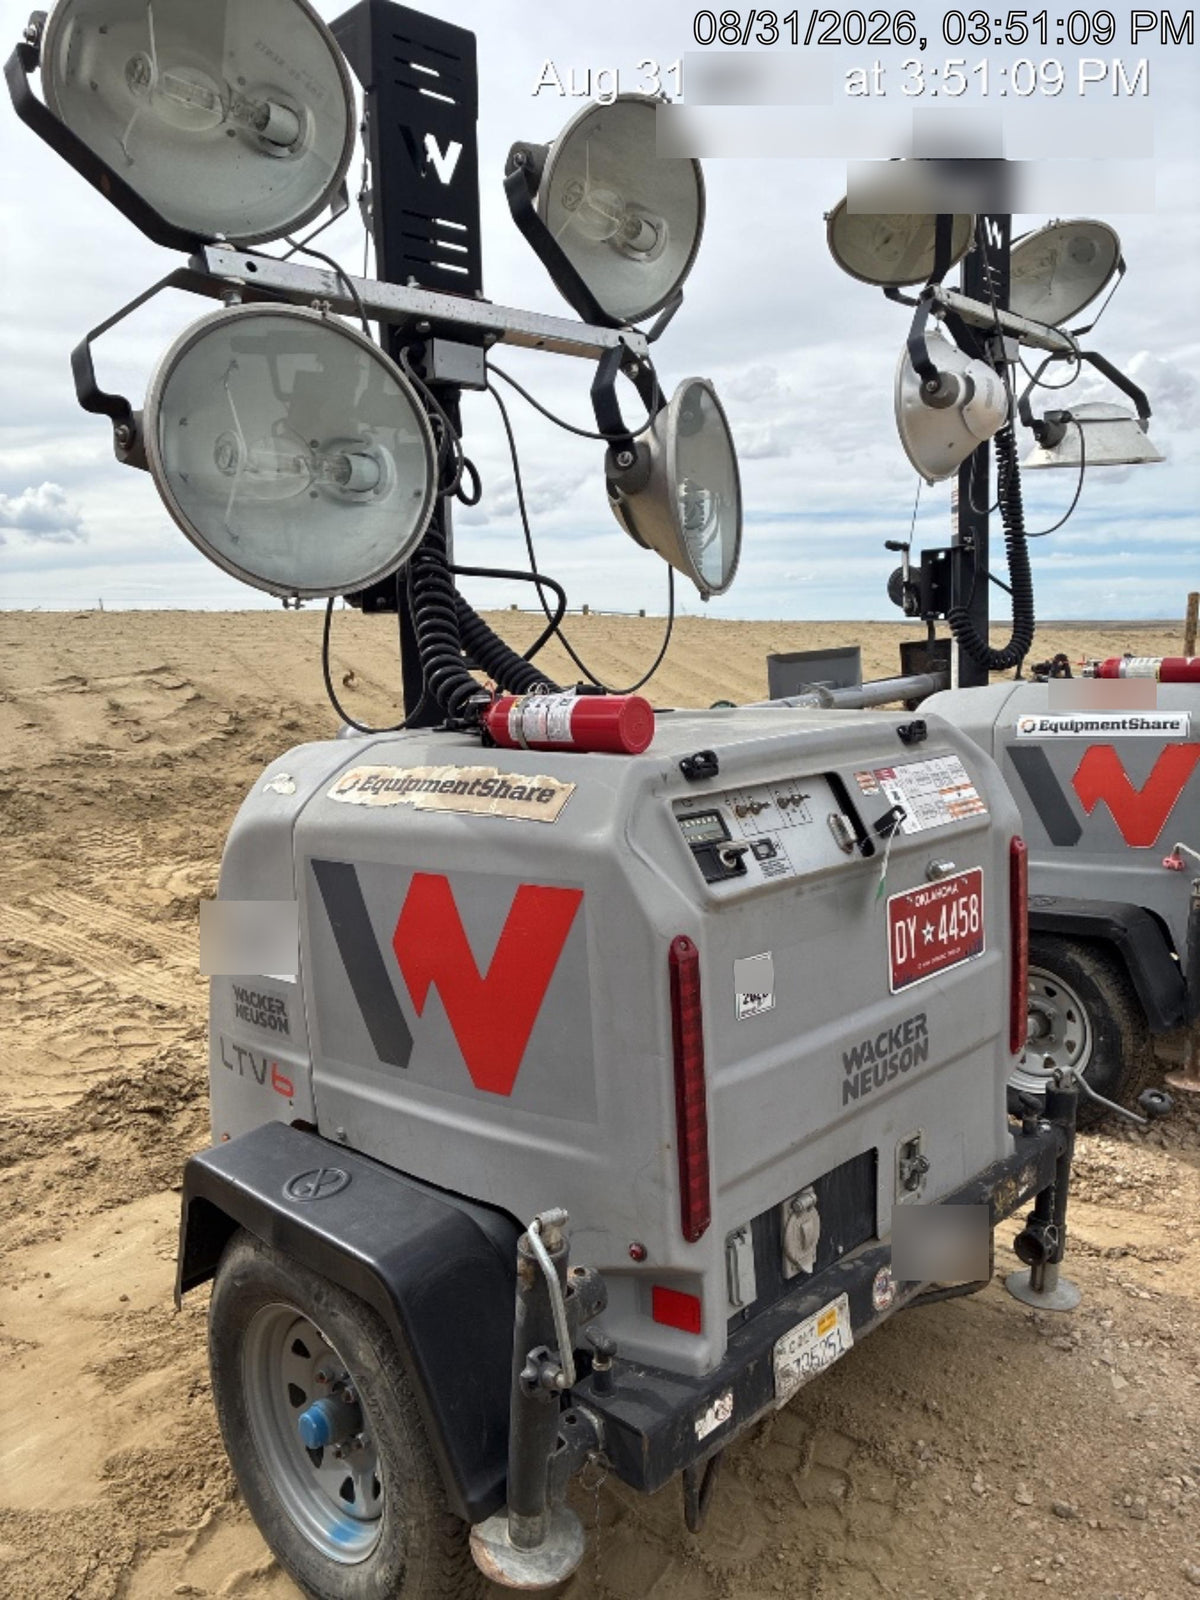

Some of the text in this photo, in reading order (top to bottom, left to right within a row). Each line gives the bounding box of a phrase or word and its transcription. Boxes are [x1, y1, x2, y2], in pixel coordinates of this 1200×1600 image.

[1038, 718, 1181, 733] EquipmentShare
[357, 774, 556, 804] EquipmentShare
[915, 883, 960, 907] OKLAHOMA
[895, 915, 917, 965] DY
[939, 894, 979, 945] 4458
[232, 983, 288, 1017] WACKER
[235, 1002, 290, 1035] NEUSON
[842, 1012, 928, 1076] WACKER
[842, 1036, 929, 1107] NEUSON
